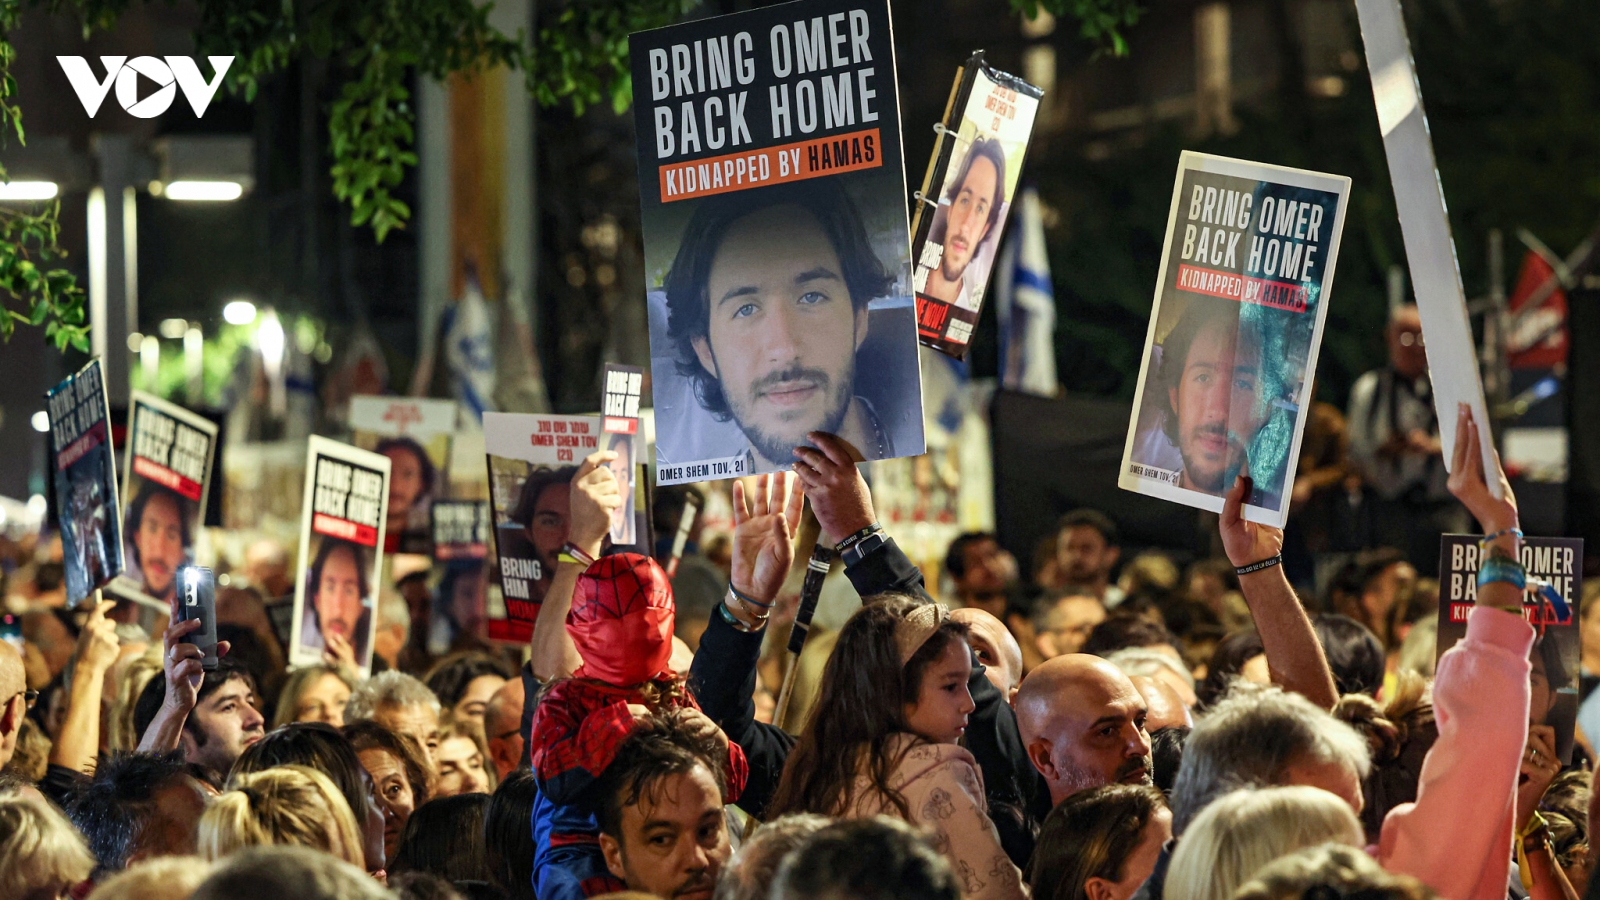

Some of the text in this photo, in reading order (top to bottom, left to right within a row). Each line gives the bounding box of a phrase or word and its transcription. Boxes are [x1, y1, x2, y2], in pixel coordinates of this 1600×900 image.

[649, 9, 873, 101] BRING OMER
[654, 68, 880, 158] BACK HOME
[665, 135, 875, 196] KIDNAPPED BY HAMAS
[1188, 184, 1324, 243] BRING OMER
[919, 240, 944, 271] BRING
[1181, 223, 1318, 283] BACK HOME
[1180, 268, 1305, 308] KIDNAPPED BY HAMAS
[531, 433, 597, 448] OMER SHEM TOV
[660, 460, 744, 481] OMER SHEM TOV, 21
[1130, 464, 1143, 475] OMER
[1145, 468, 1158, 479] SHEM
[501, 556, 542, 580] BRING
[1521, 546, 1574, 575] OMER
[503, 577, 529, 599] HIM
[1450, 572, 1478, 601] BA
